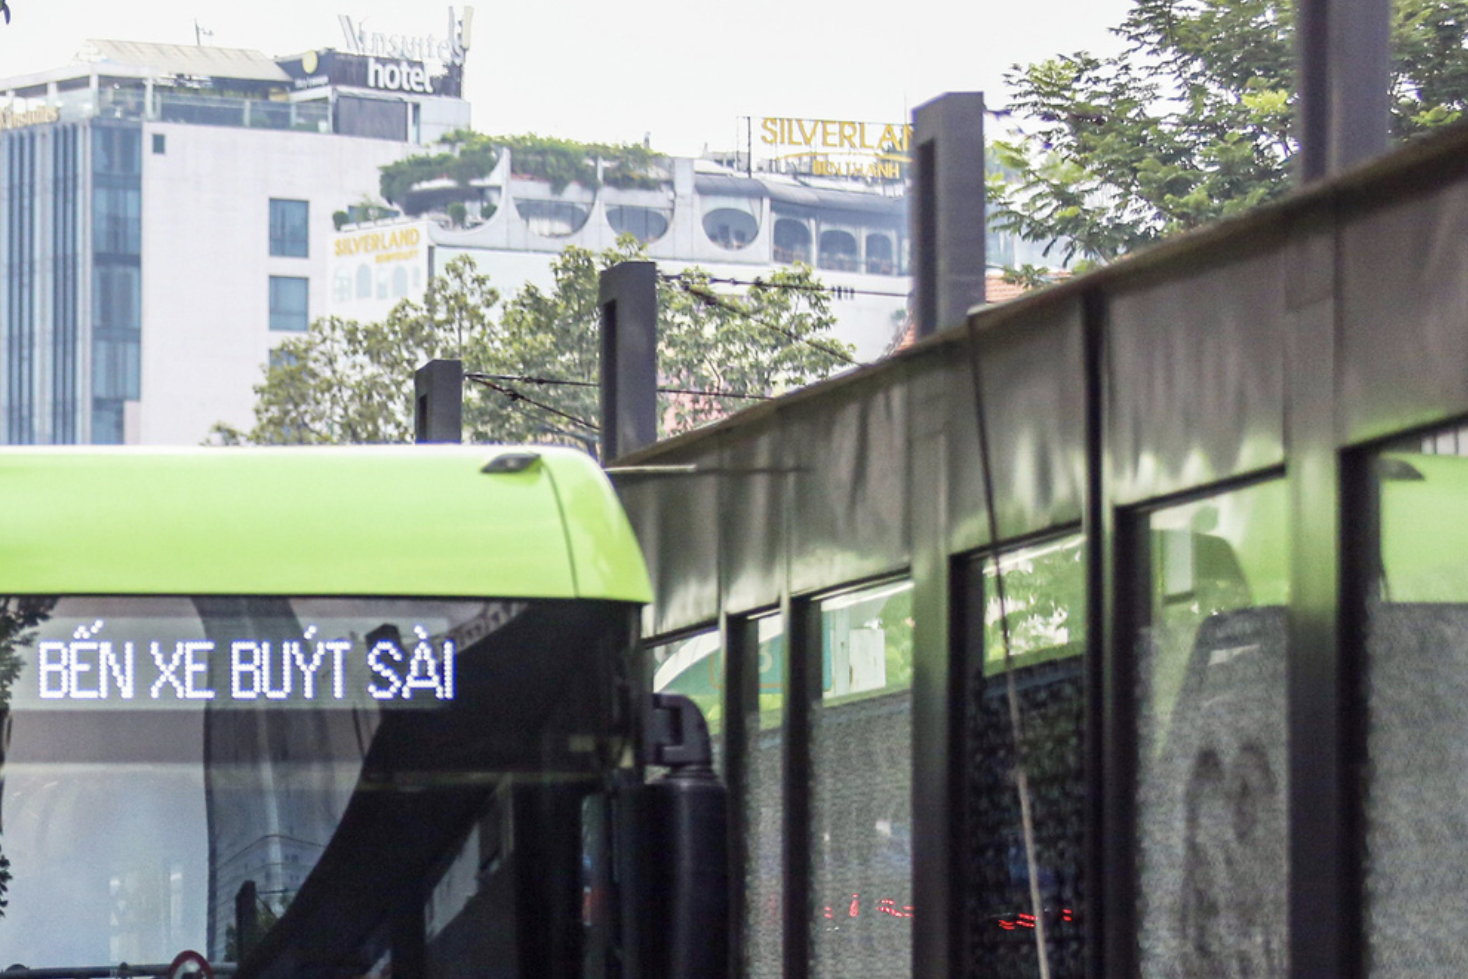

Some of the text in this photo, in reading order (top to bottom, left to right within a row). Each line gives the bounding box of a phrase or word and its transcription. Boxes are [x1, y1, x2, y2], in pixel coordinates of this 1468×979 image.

[367, 57, 434, 93] hotel
[38, 618, 456, 700] BẾN XE BUÝT SÀI
